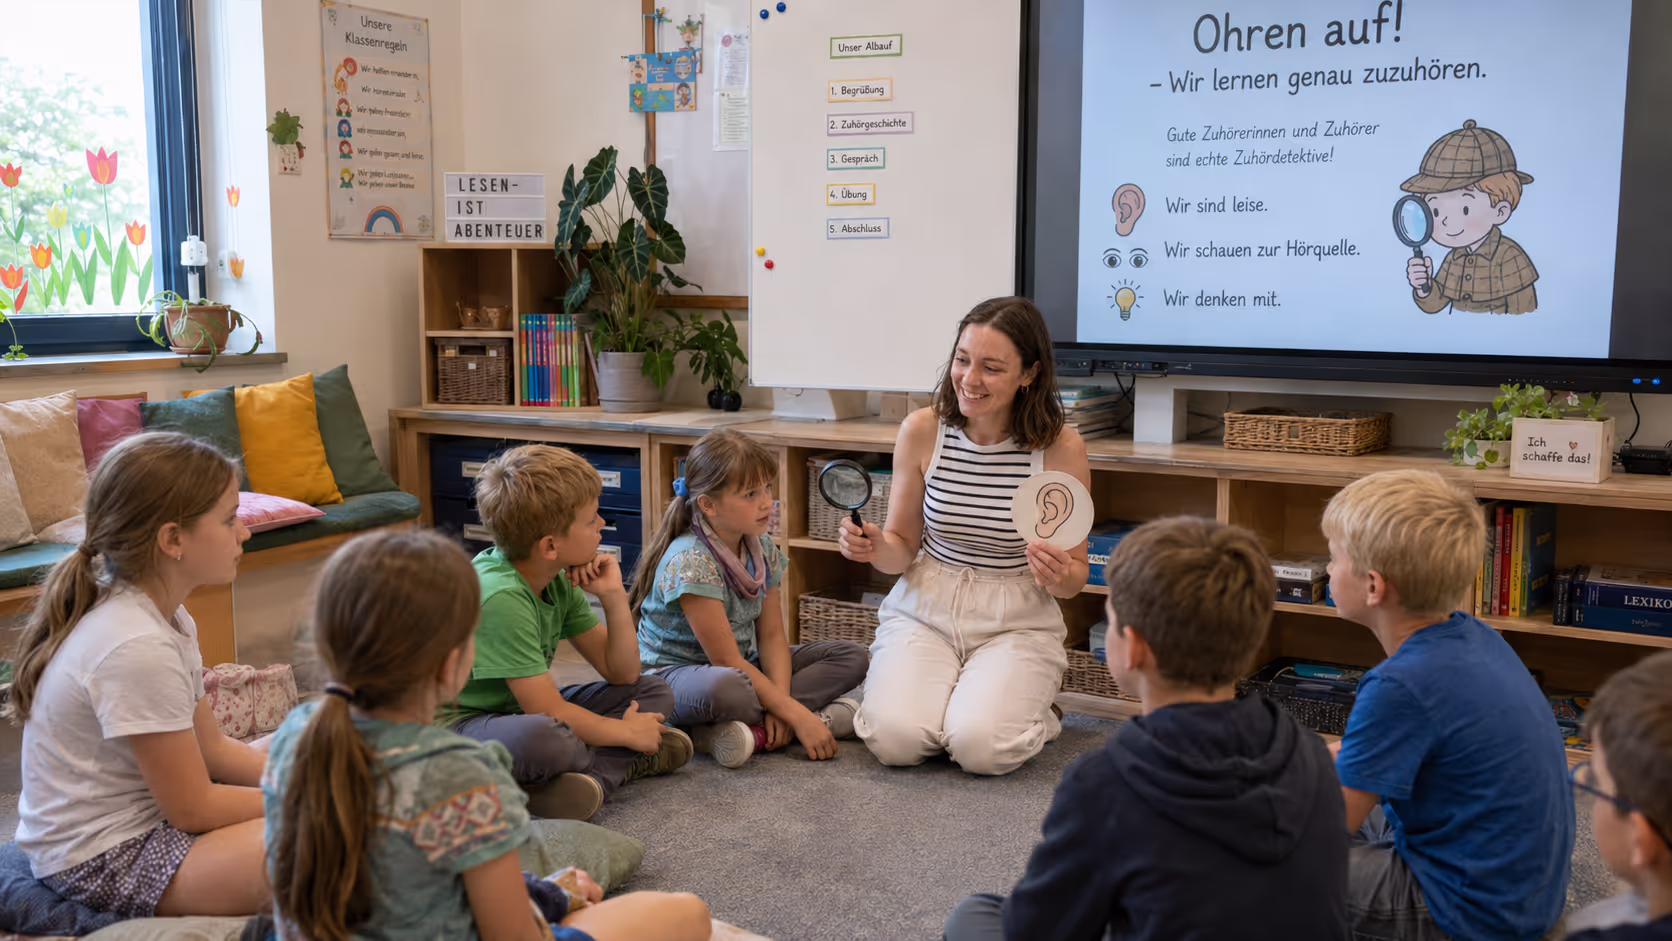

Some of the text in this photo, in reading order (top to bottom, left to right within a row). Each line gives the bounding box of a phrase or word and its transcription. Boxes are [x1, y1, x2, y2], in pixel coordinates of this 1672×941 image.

[361, 16, 392, 31] Unsere
[1193, 0, 1402, 54] Ohren auf!
[345, 32, 408, 53] Klassenregeln
[838, 40, 893, 53] Unser Albauf
[1168, 70, 1204, 93] Wir
[1213, 68, 1278, 91] lernen
[1288, 69, 1352, 95] genau
[1363, 56, 1487, 83] zuzuhören.
[831, 85, 884, 97] 1. Begrüßung
[829, 118, 907, 132] 2. Zuhörgeschichte
[1167, 120, 1380, 142] Gute Zuhörerinnen und Zuhörer
[830, 154, 878, 165] 3. Gespräch
[1166, 147, 1334, 168] sind echte Zuhördetektive!
[458, 177, 518, 193] LESEN-
[830, 188, 867, 200] 4. Übung
[457, 200, 484, 216] IST
[1166, 195, 1268, 214] Wir sind leise.
[454, 223, 543, 238] ABENTEUER
[830, 224, 882, 234] 5. Abschluss
[1165, 238, 1360, 262] Wir schauen zur Hörquelle.
[1163, 289, 1281, 307] Wir denken mit.
[1527, 437, 1546, 448] Ich
[1523, 451, 1591, 464] schaffe das!
[1623, 595, 1672, 609] LEXIKO
